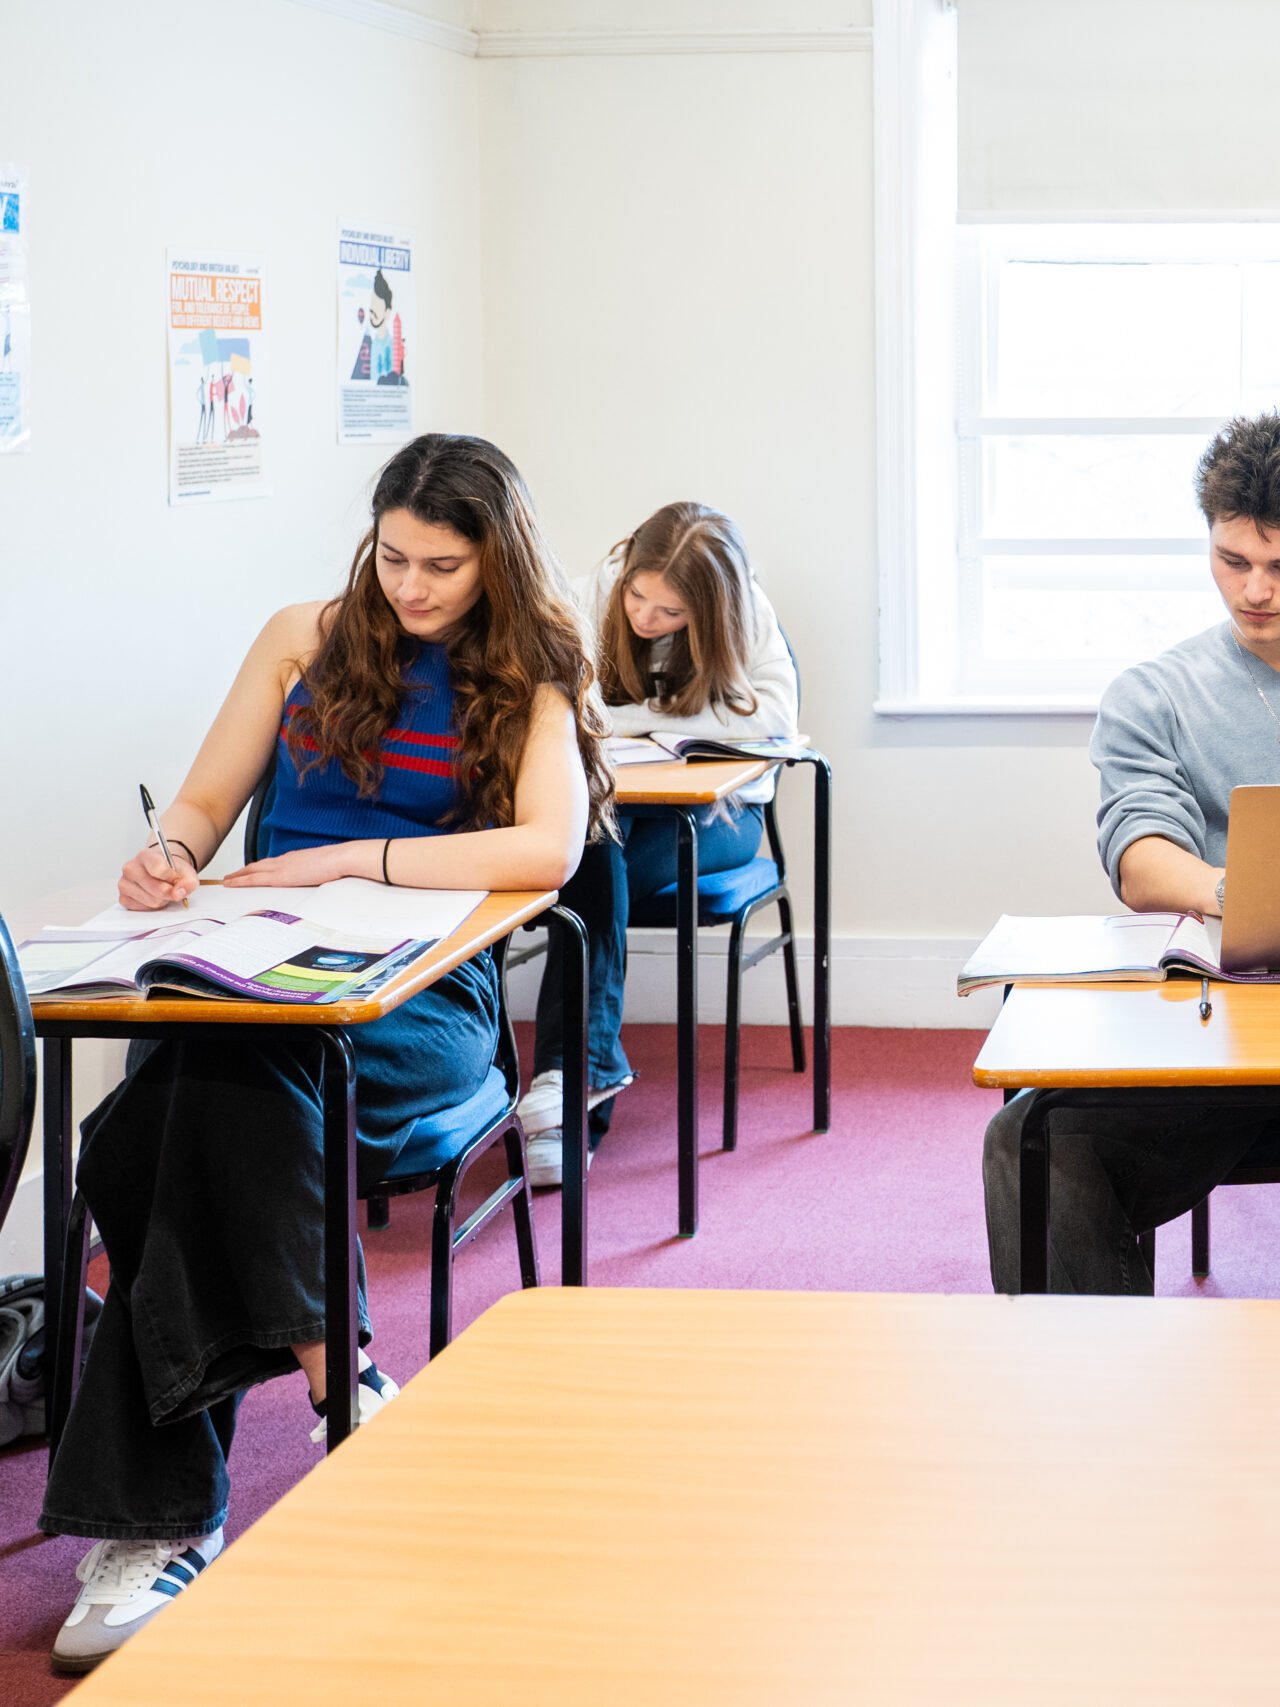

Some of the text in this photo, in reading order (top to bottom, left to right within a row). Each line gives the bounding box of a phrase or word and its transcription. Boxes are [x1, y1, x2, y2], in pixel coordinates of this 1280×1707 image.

[341, 242, 409, 270] INDIVIDUAL LIBERTY
[171, 276, 259, 304] MUTUAL RESPECT
